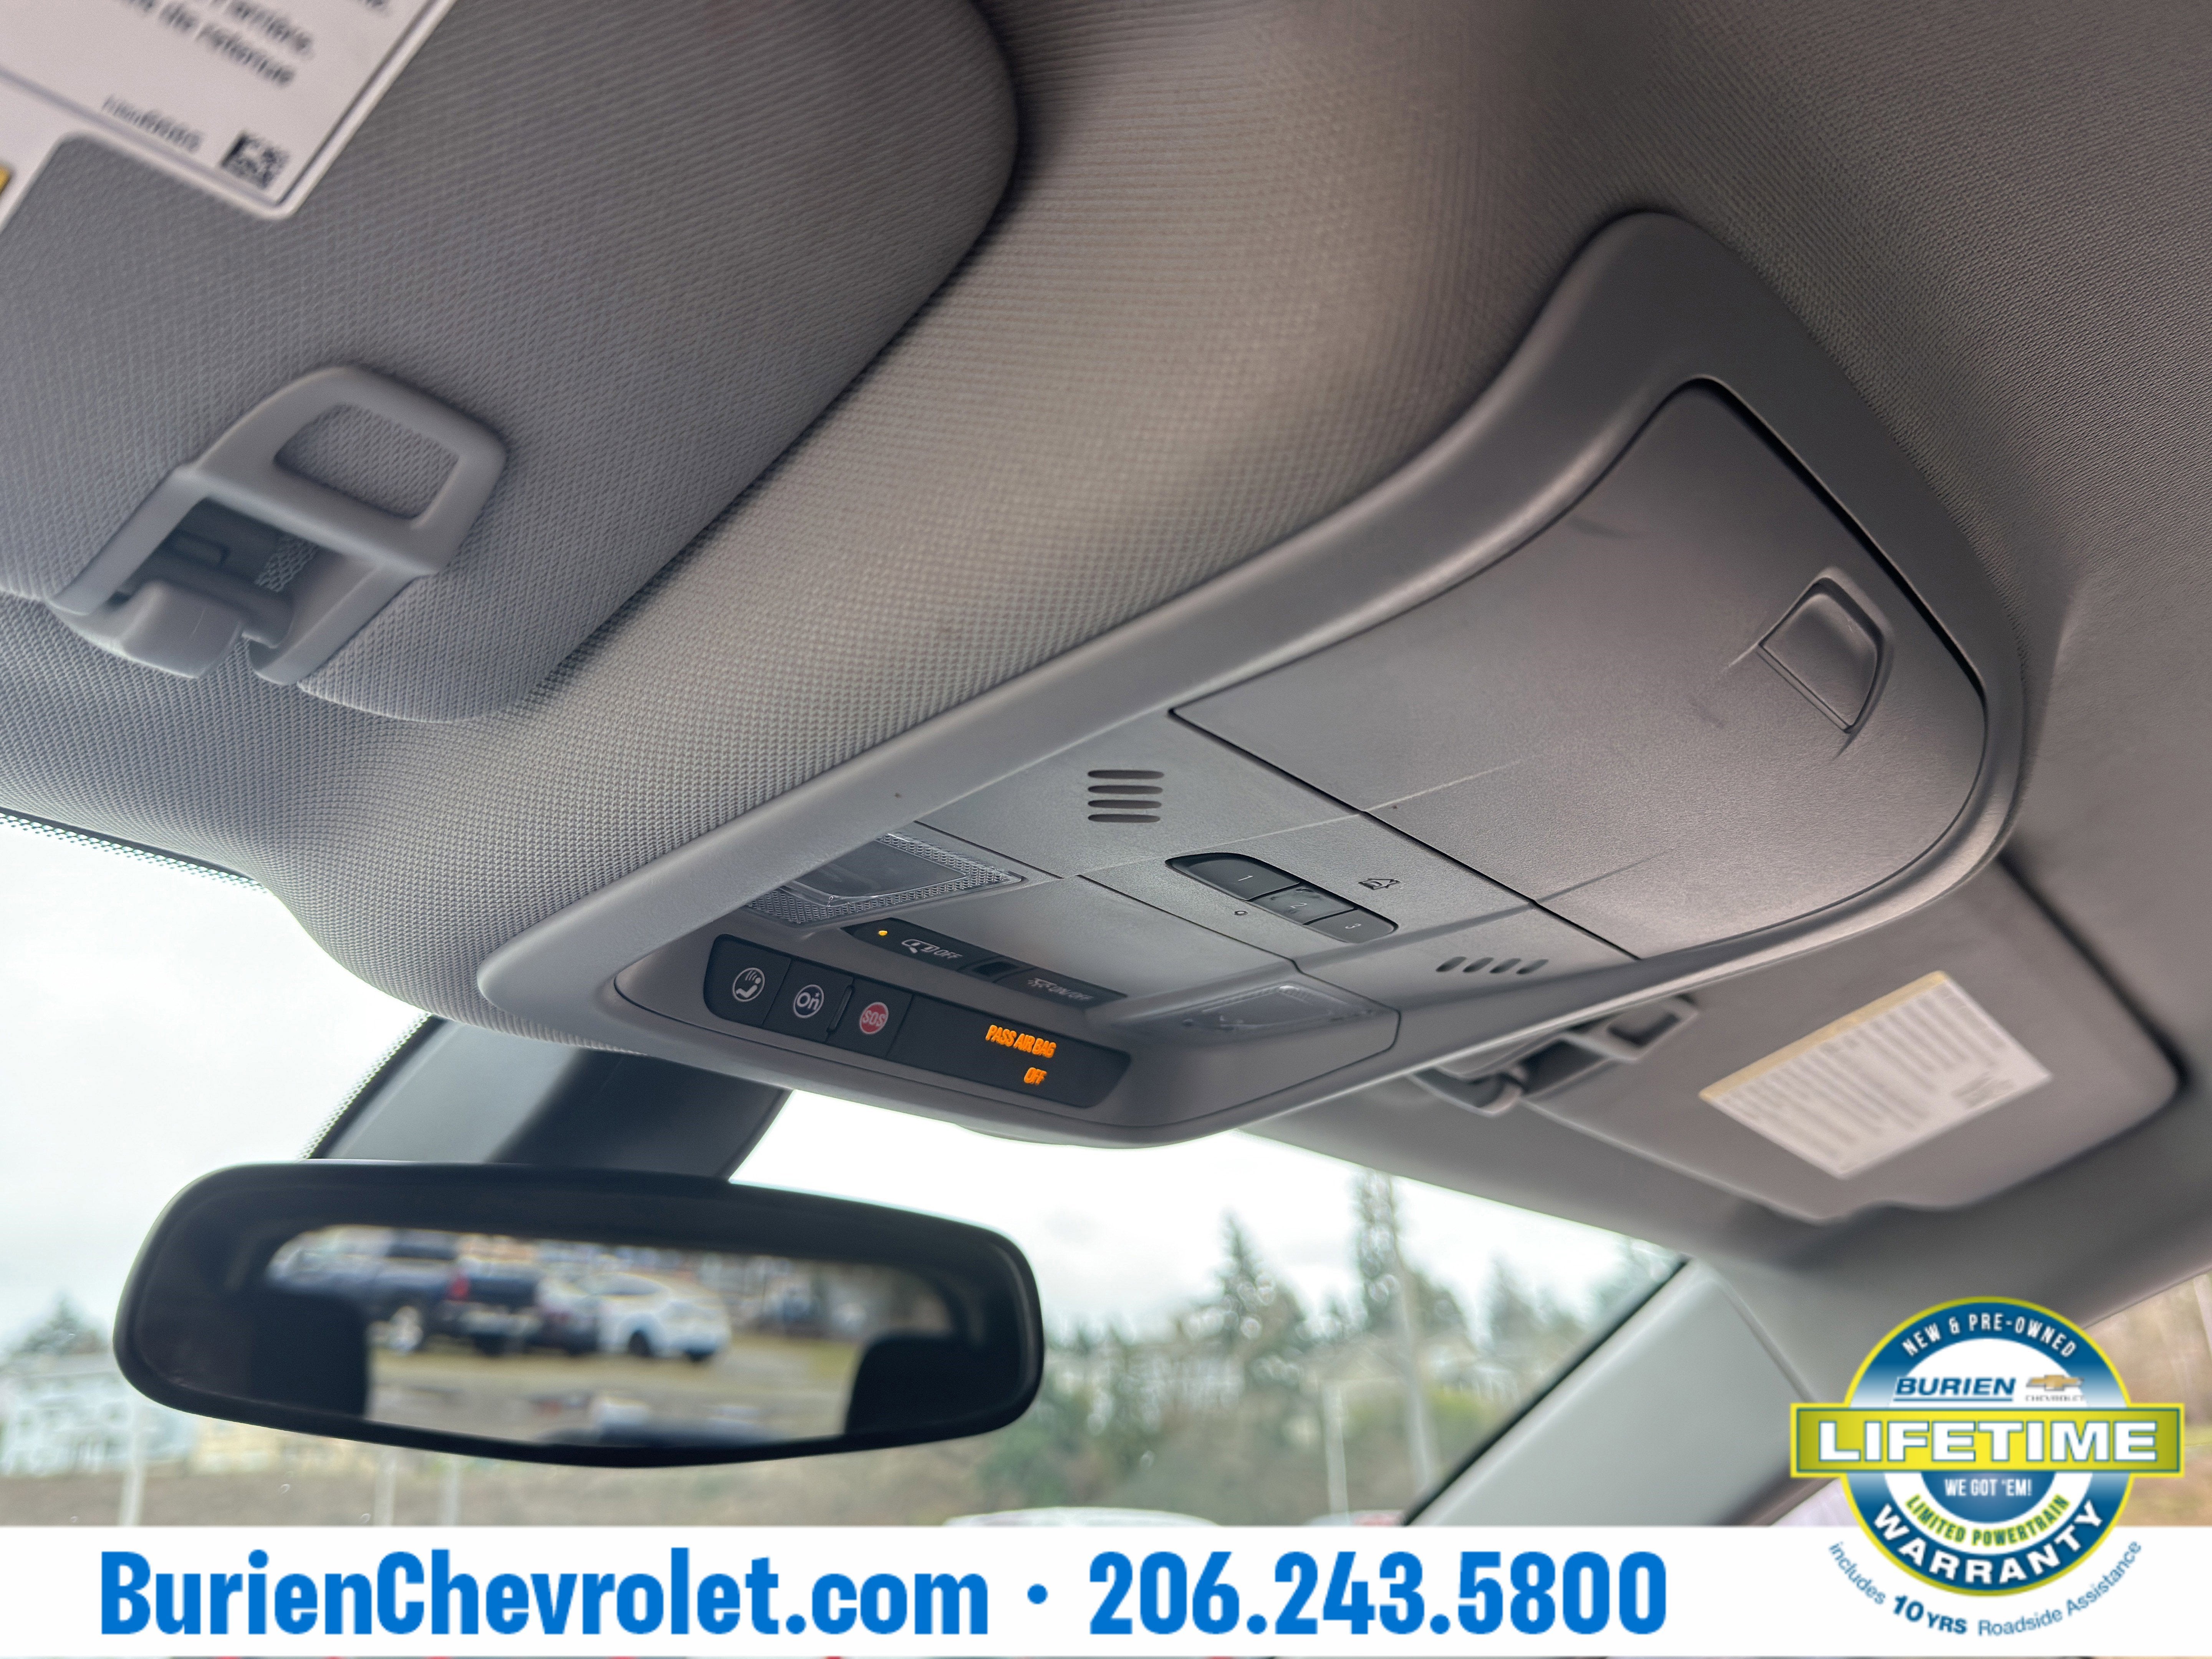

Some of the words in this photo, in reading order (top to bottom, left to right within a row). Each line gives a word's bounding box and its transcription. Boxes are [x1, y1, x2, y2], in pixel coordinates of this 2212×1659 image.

[933, 949, 963, 959] OFF
[862, 1009, 886, 1028] SOS
[985, 1025, 1017, 1047] PASS
[1013, 1033, 1036, 1053] AIR
[1032, 1038, 1057, 1058] BAG
[1023, 1067, 1048, 1085] OFF
